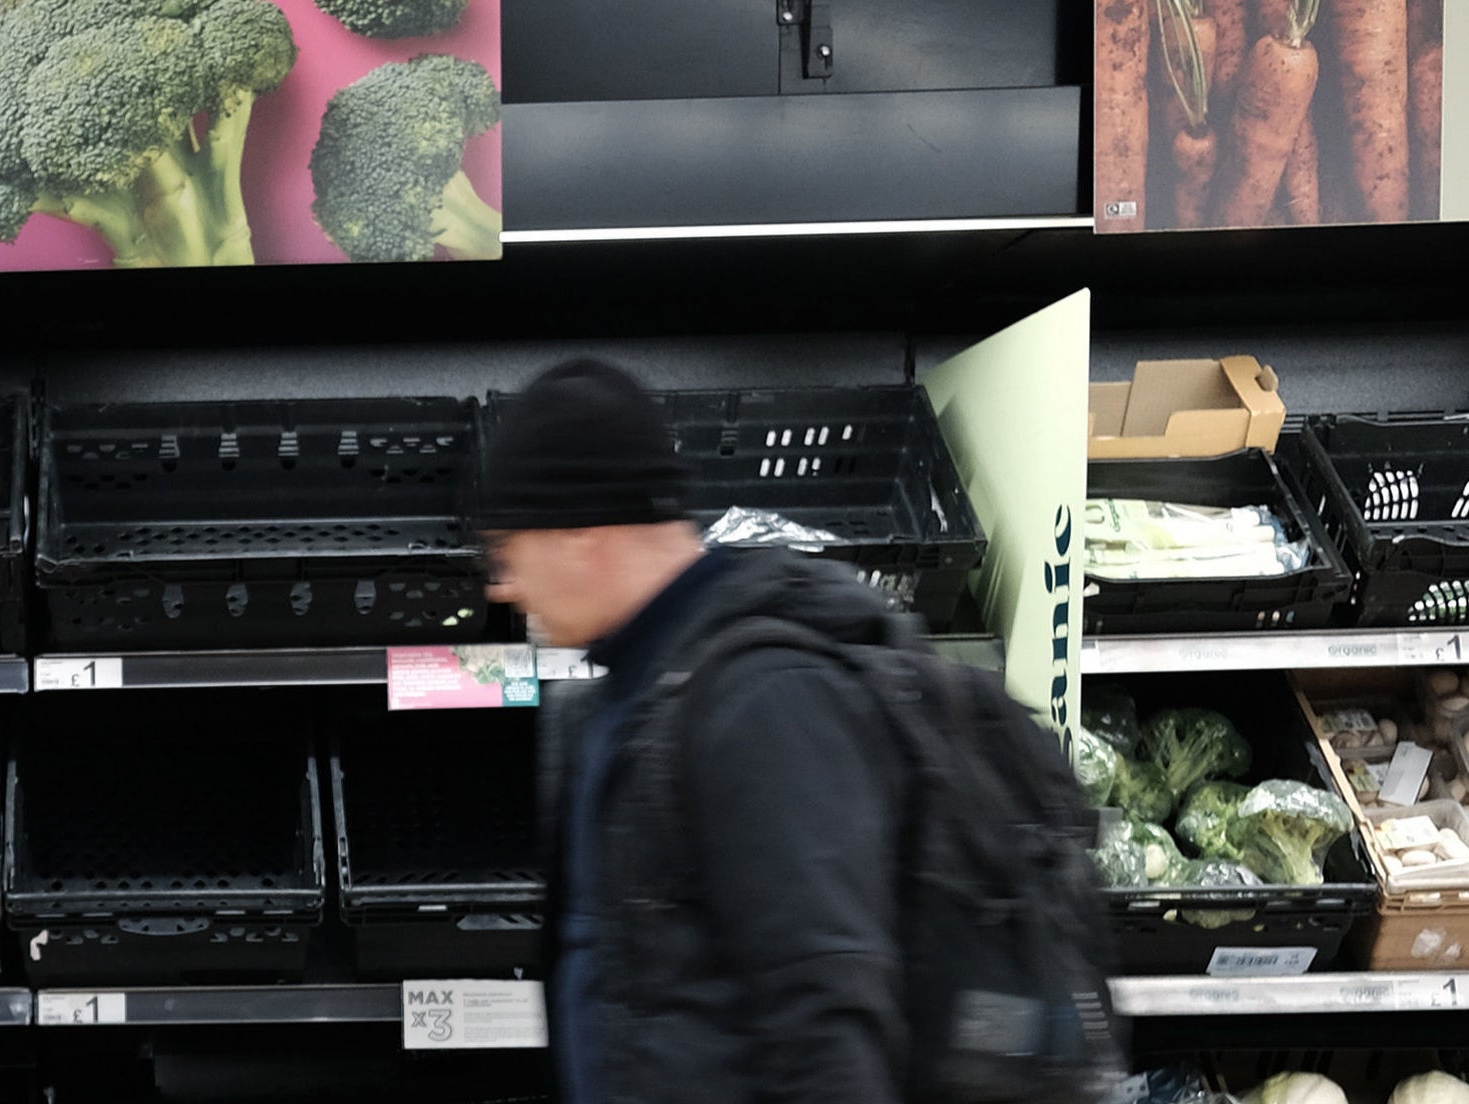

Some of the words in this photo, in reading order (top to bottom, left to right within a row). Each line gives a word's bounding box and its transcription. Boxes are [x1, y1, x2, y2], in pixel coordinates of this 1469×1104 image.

[71, 660, 96, 688] £1
[73, 996, 98, 1024] £1
[408, 990, 454, 1005] MAX
